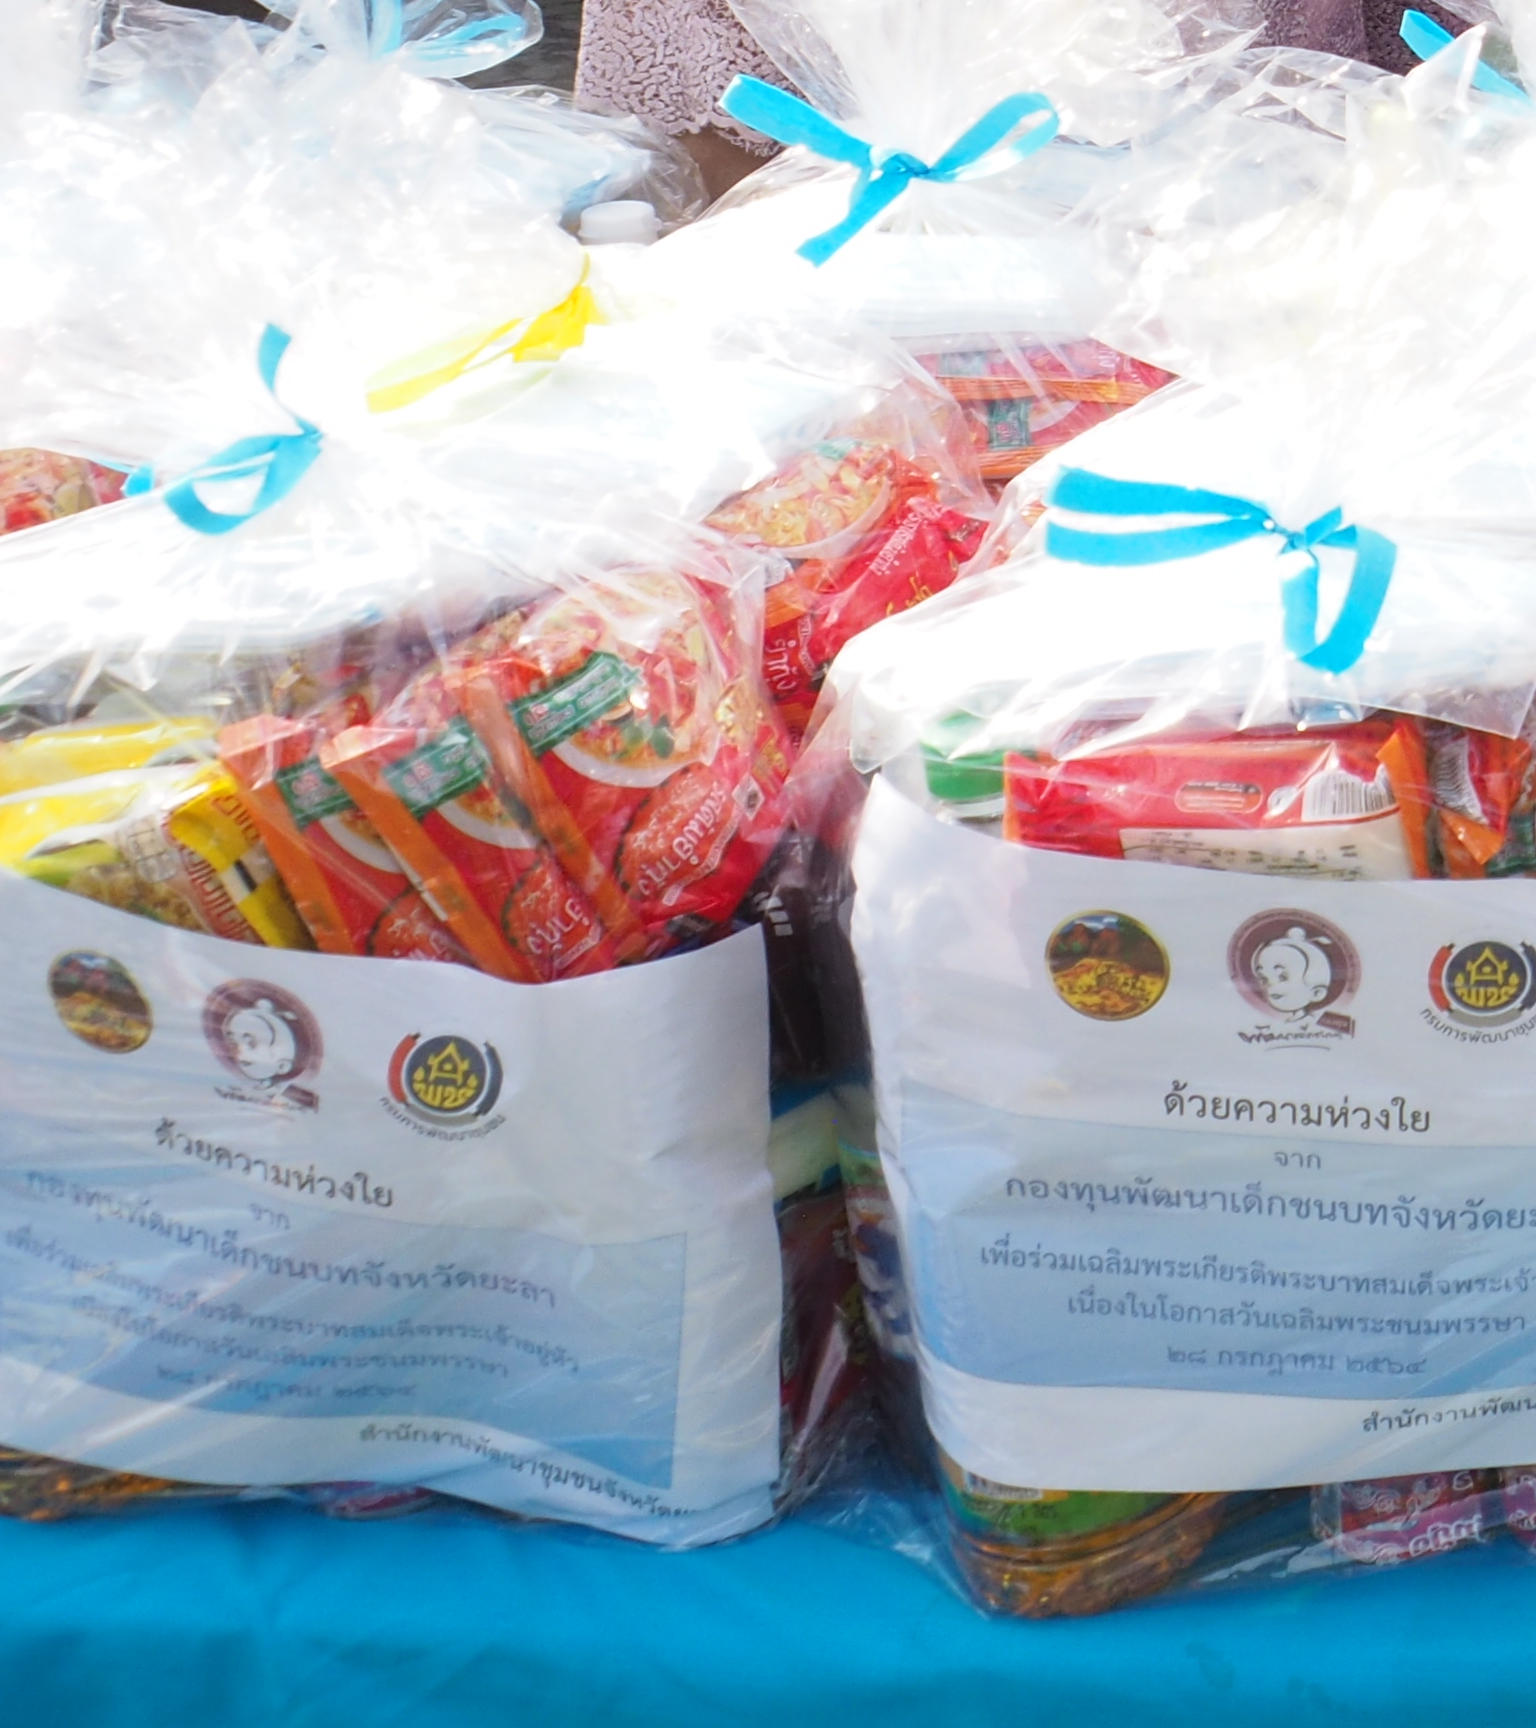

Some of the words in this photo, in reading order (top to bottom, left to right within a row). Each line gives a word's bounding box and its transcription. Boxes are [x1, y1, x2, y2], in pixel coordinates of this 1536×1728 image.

[1164, 1080, 1431, 1133] ด้วยความห่วงใย
[154, 1116, 394, 1208] ด้วยความห่วงใย
[1274, 1151, 1322, 1170] จาก
[250, 1202, 292, 1231] จาก
[1067, 1283, 1527, 1334] เนื่องในโอกาสวันเฉลิมพระชนมพรรษา
[1167, 1345, 1207, 1366] ๒๘
[1217, 1348, 1335, 1376] กรกฎาคม
